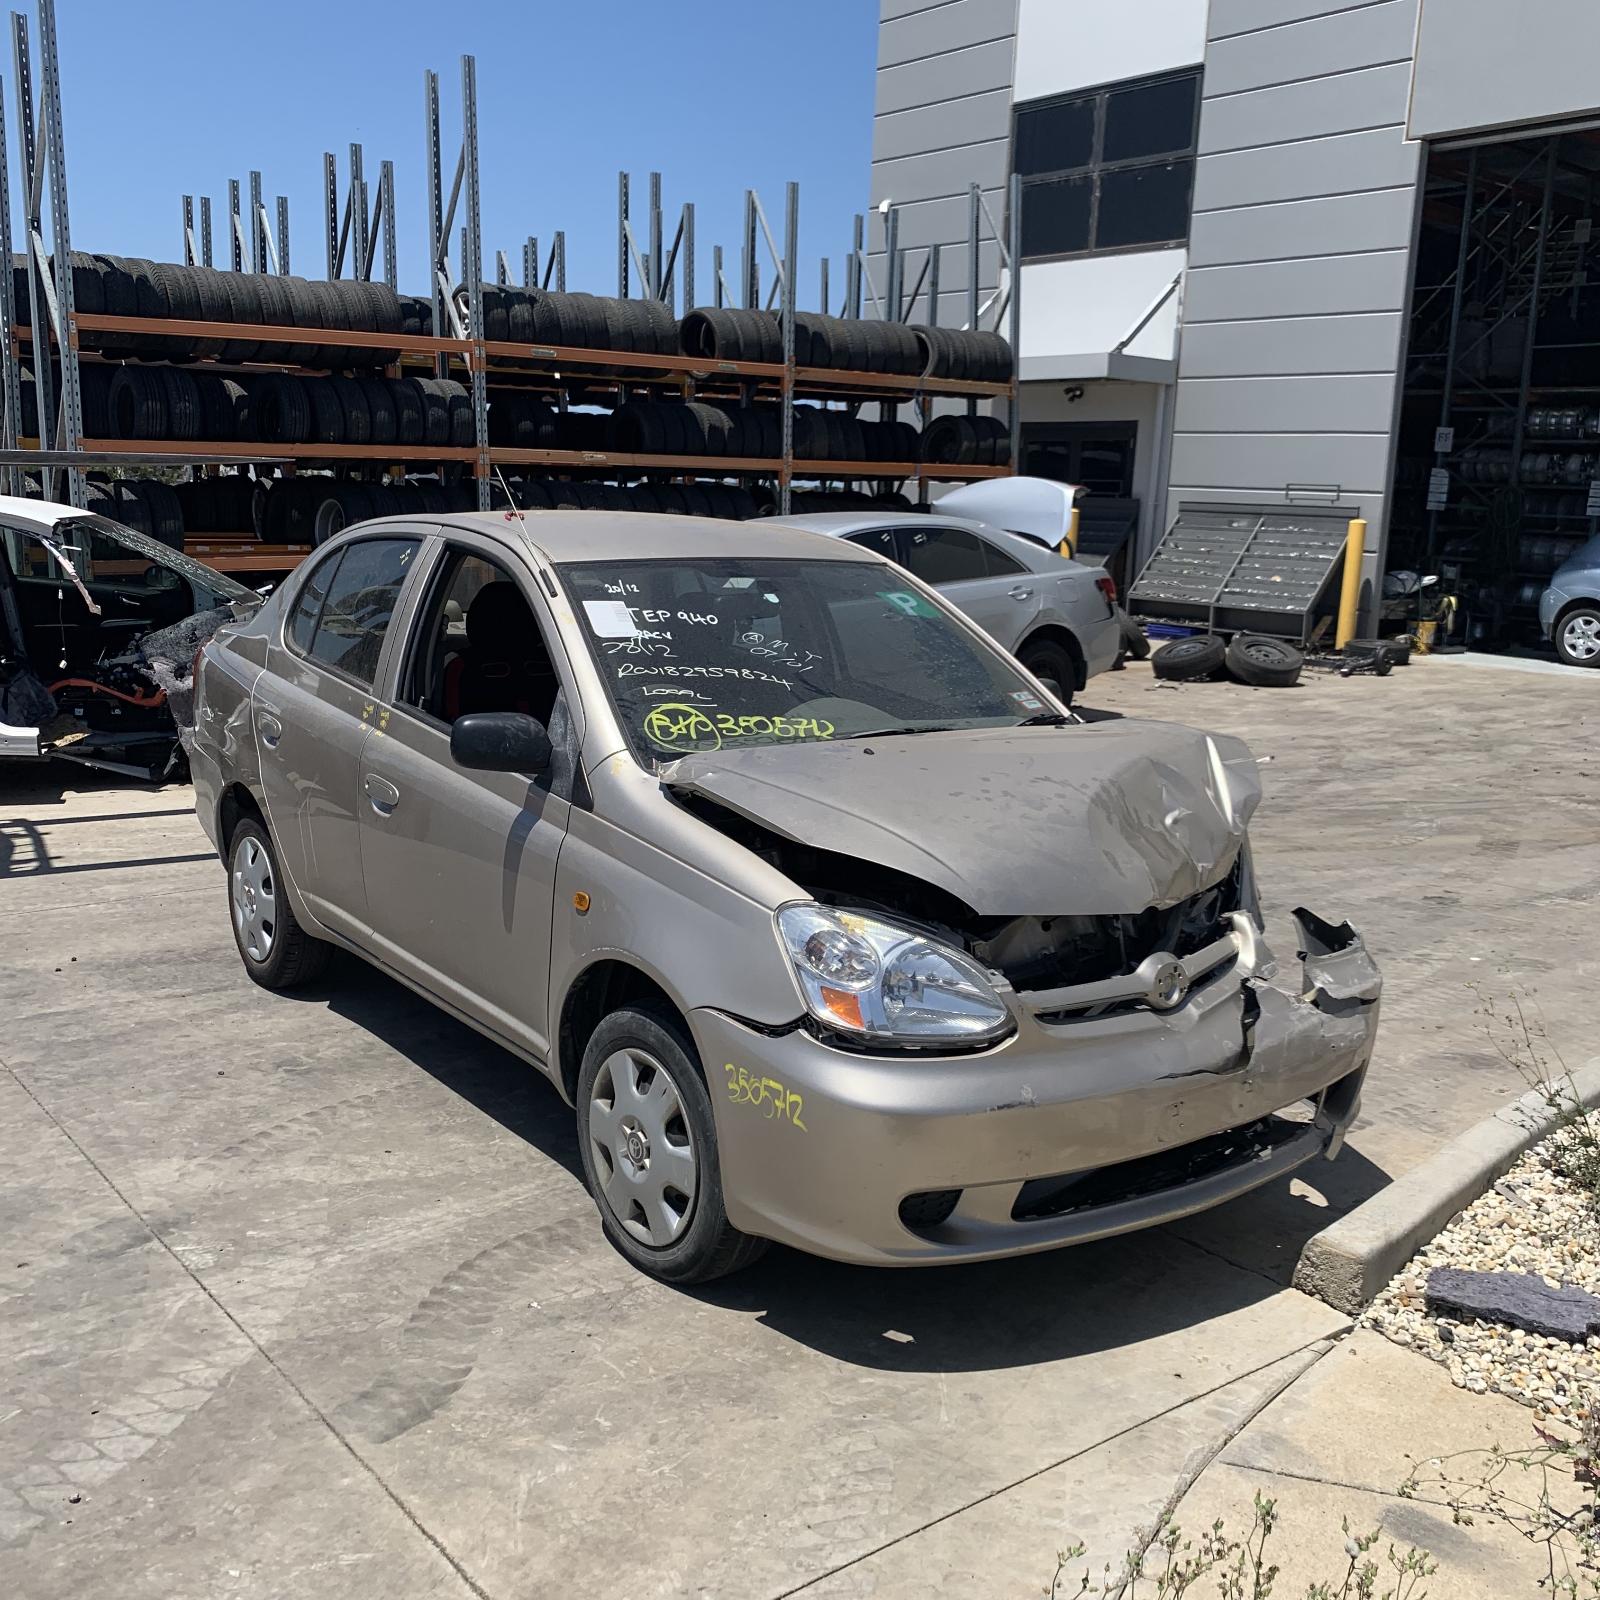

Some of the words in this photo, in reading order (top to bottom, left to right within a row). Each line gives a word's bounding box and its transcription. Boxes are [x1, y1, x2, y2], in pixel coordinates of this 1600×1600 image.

[604, 580, 640, 596] 20/12
[886, 592, 919, 617] P
[626, 607, 671, 623] TEP
[677, 609, 719, 625] 940
[602, 636, 680, 658] 28/12
